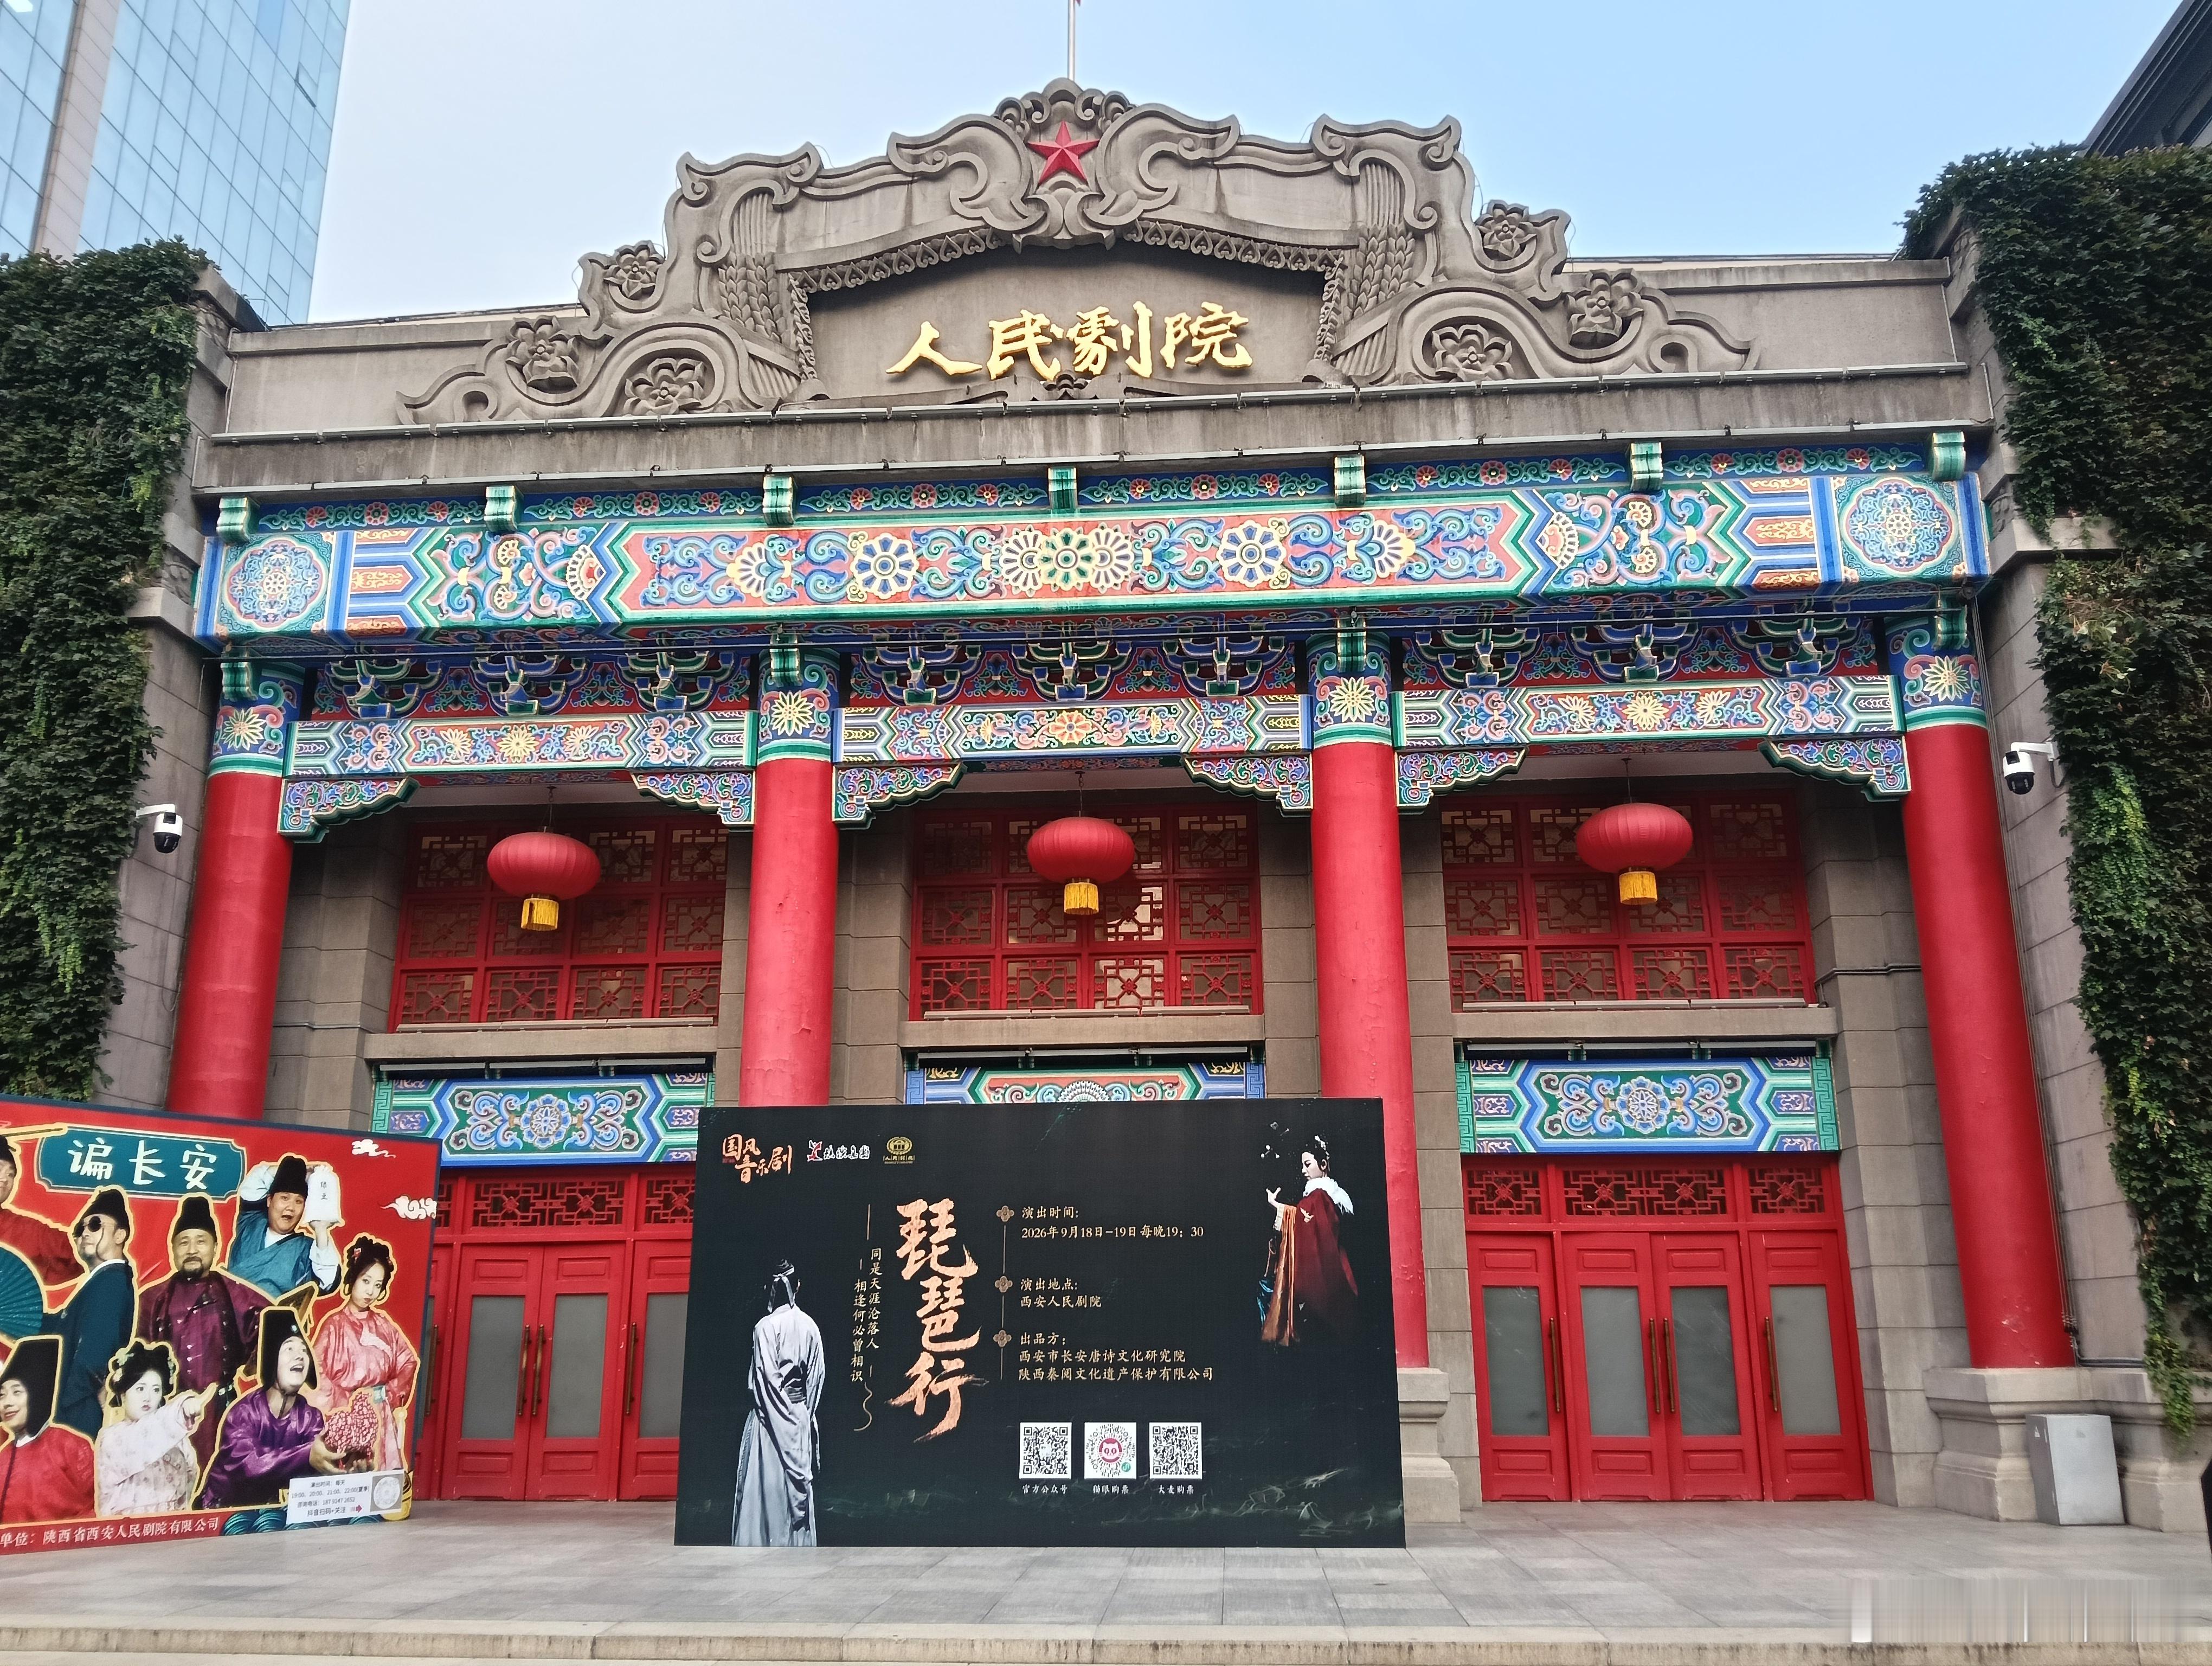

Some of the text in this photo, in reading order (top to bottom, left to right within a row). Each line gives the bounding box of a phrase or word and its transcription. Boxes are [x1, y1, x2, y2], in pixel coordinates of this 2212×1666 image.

[67, 1137, 217, 1189] 谝长安
[866, 1248, 883, 1349] 同是天涯沦落人
[885, 1198, 989, 1443] 琵琶行
[1020, 1295, 1102, 1308] 西安人民剧院
[850, 1278, 867, 1382] 相逢何必曾相识
[1019, 1348, 1186, 1364] 西安市长安唐诗文化研究院
[1022, 1484, 1068, 1495] 官方公众号
